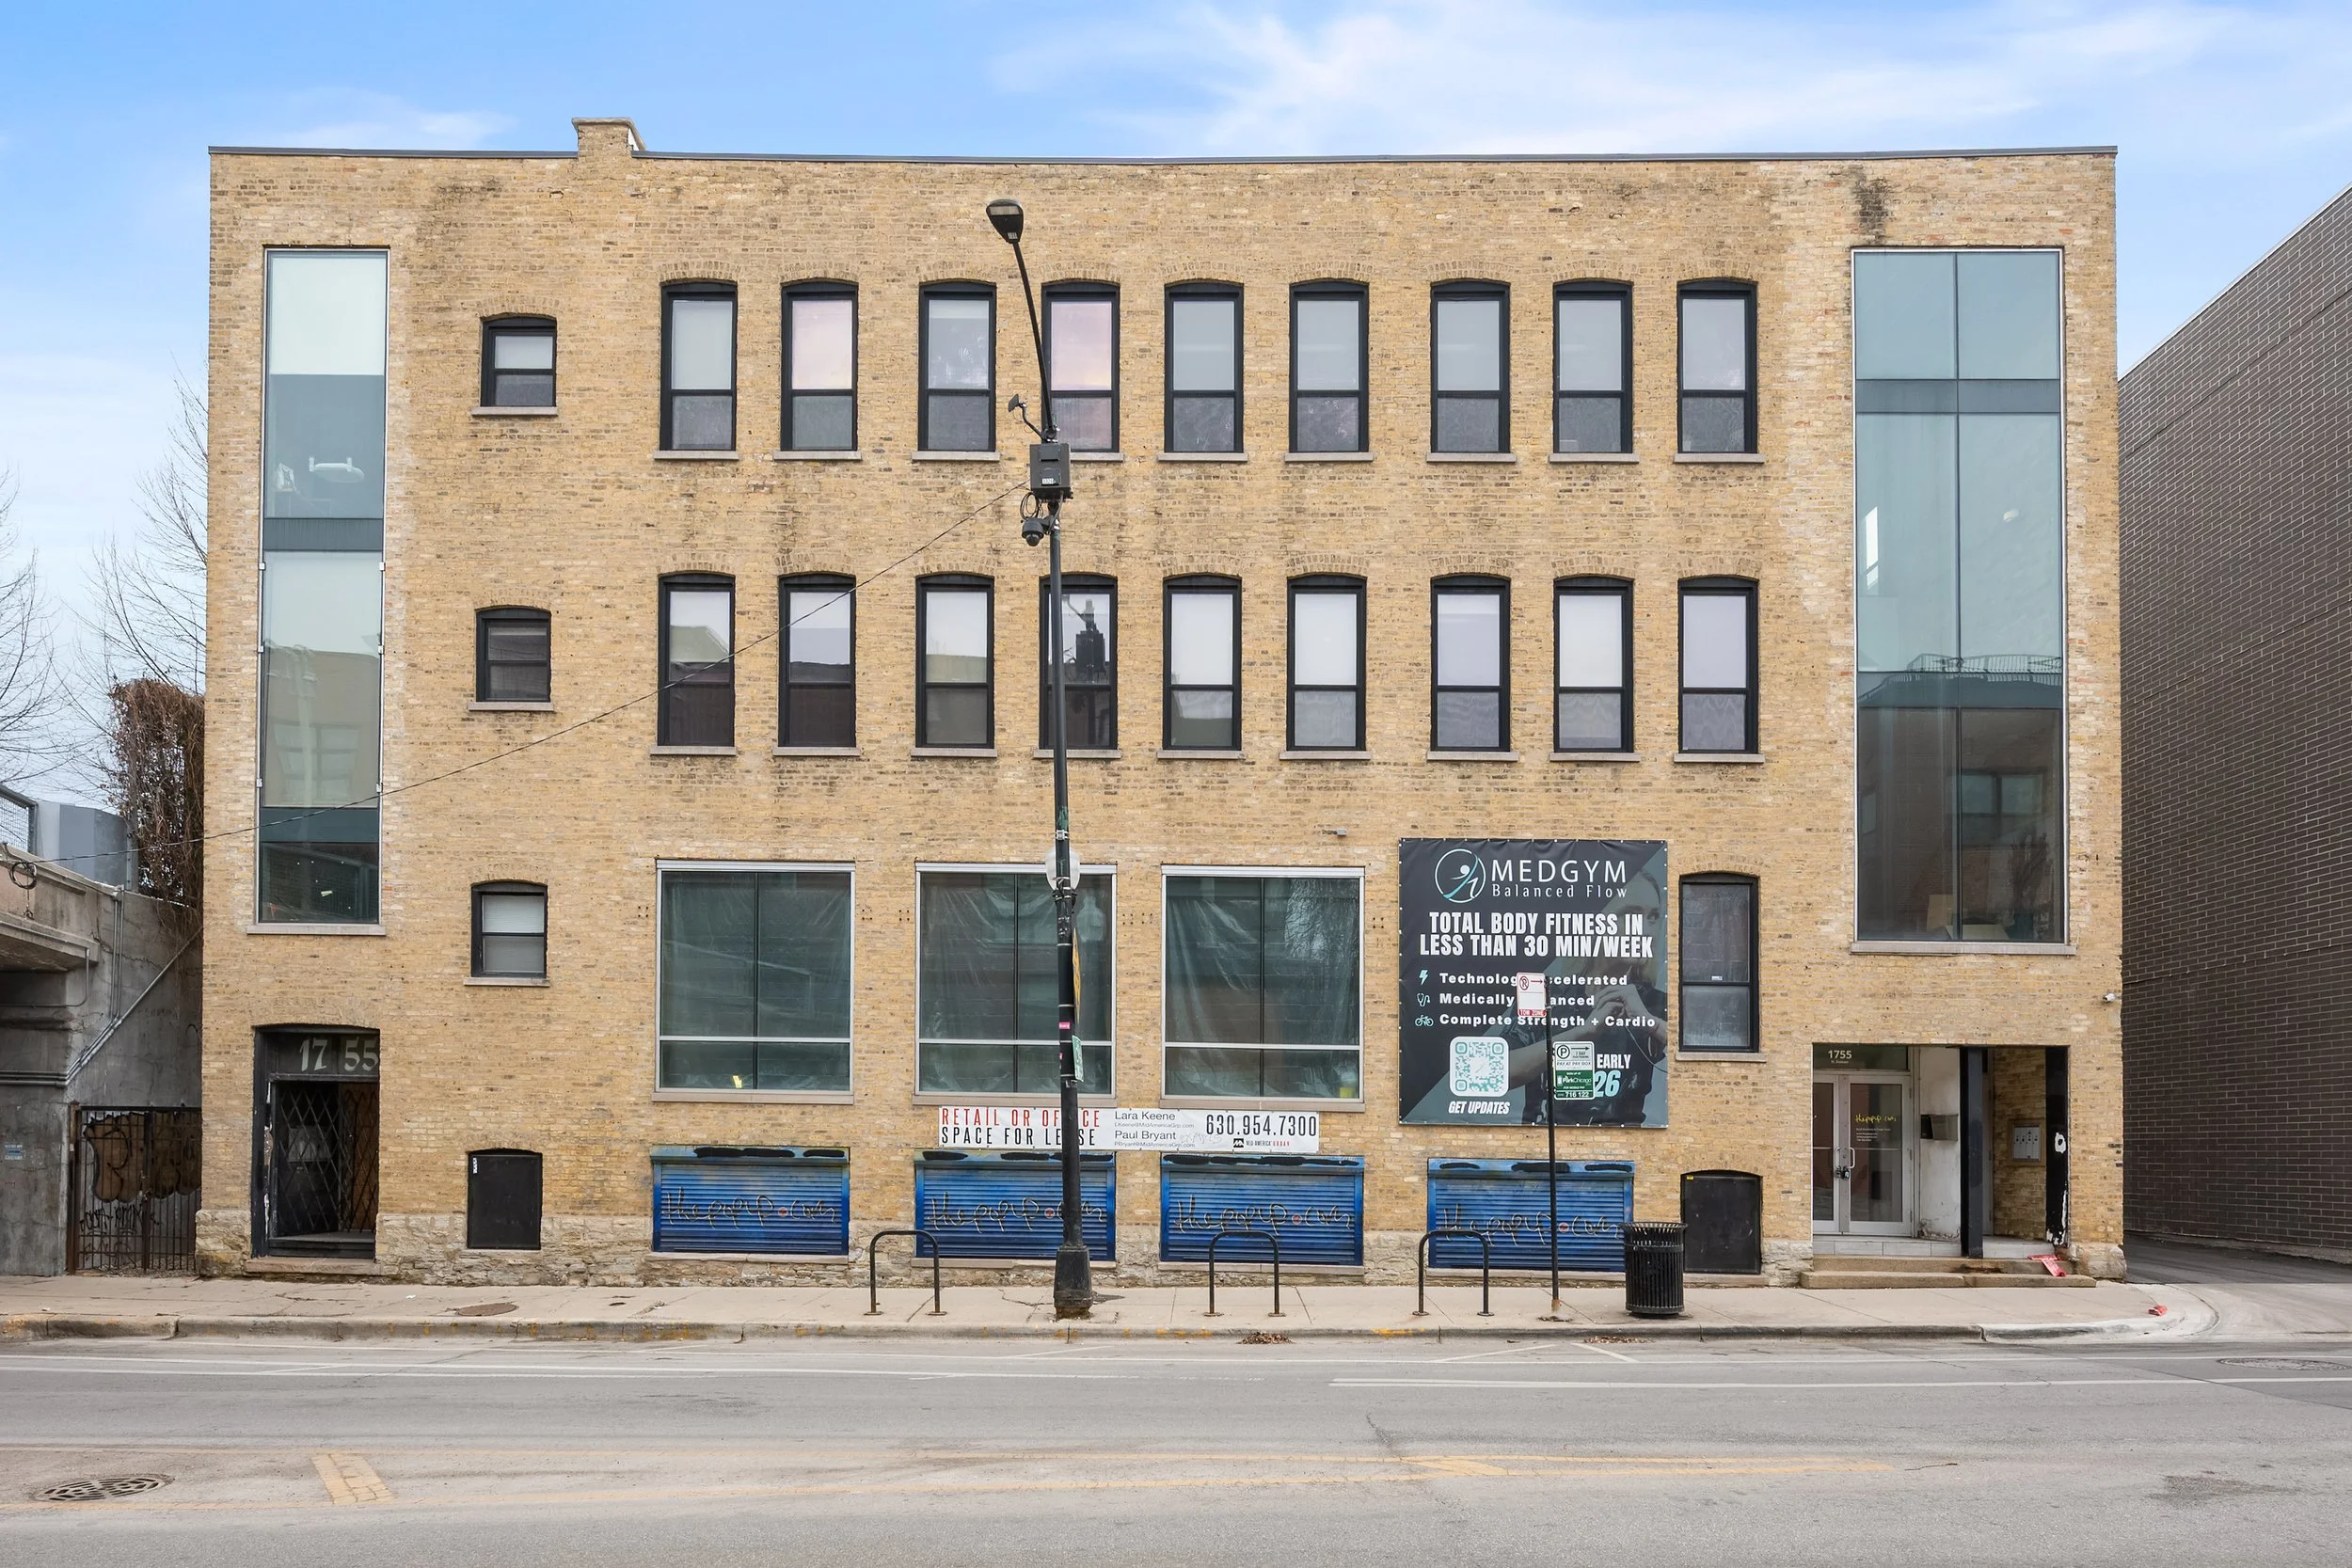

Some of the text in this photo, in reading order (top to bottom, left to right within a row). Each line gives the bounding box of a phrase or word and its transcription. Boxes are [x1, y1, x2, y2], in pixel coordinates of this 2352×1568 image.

[1491, 860, 1627, 883] MEDGYM
[1492, 884, 1628, 898] Balanced Flow
[1429, 911, 1644, 935] TOTAL BODY FITNESS IN
[1420, 934, 1653, 958] LESS THAN 30 MIN/WEEK
[1439, 973, 1517, 987] Technolog
[1439, 993, 1515, 1006] Medically
[1439, 1014, 1512, 1027] Complete
[1605, 1015, 1656, 1027] Cardio
[1596, 1053, 1631, 1069] EARLY
[1828, 1050, 1852, 1059] 1755
[1448, 1100, 1511, 1115] GET UPDATES
[942, 1107, 1100, 1127] RETAIL OR OFCE
[1115, 1111, 1176, 1120] Lara Keene
[1206, 1114, 1317, 1136] 630.954.7300
[942, 1127, 1096, 1146] SPACE FOR LESE
[1115, 1131, 1138, 1140] Paul
[1141, 1131, 1176, 1142] Bryant
